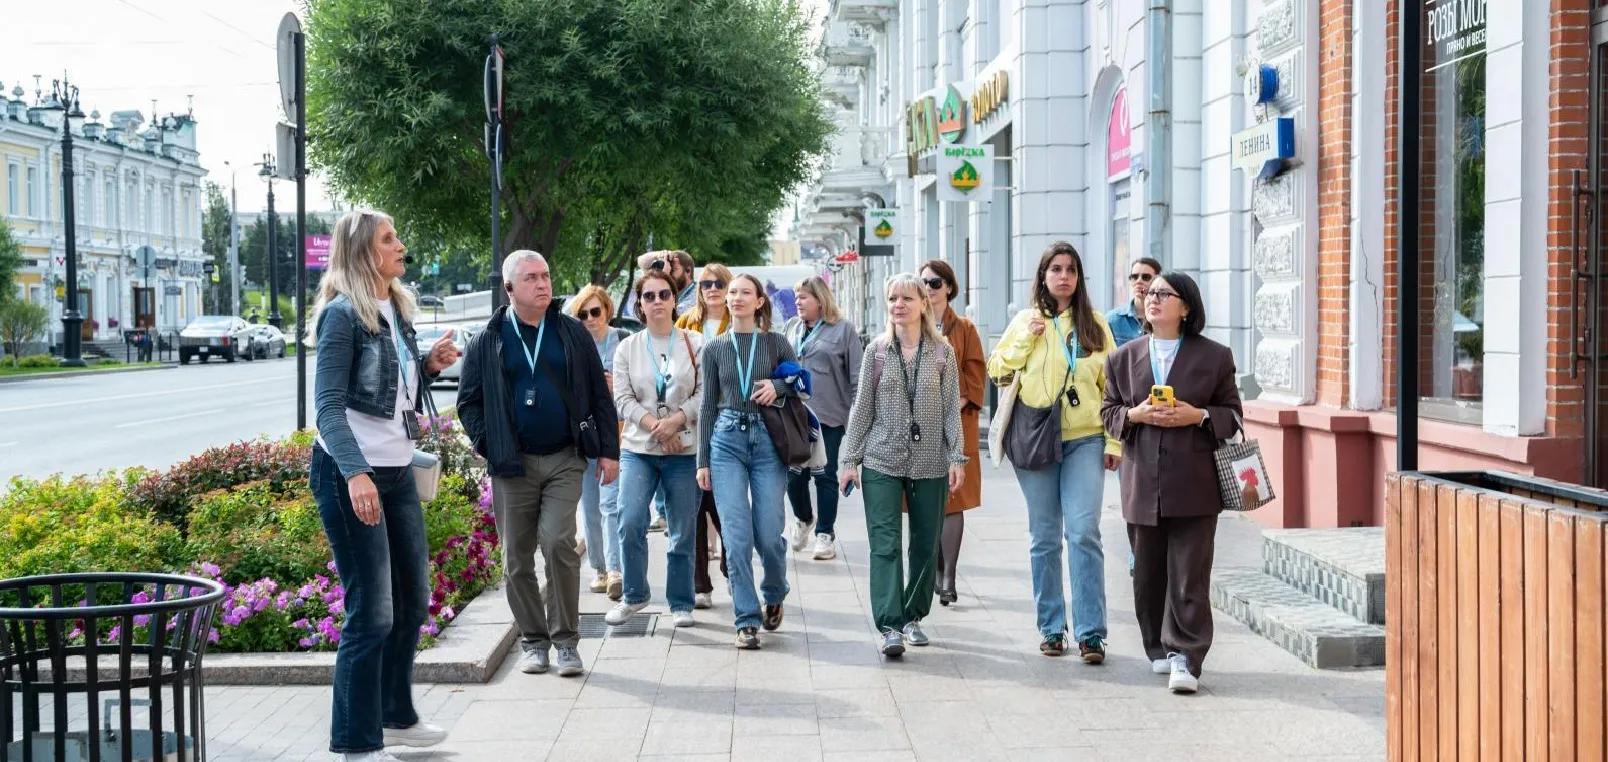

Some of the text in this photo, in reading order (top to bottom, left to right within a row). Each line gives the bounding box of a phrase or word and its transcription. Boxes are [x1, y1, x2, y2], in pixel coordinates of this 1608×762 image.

[1427, 0, 1457, 45] РОЗЫ
[1446, 37, 1465, 55] ПРЯНО
[1466, 33, 1471, 48] И
[1240, 132, 1270, 158] ЛЕНИНА
